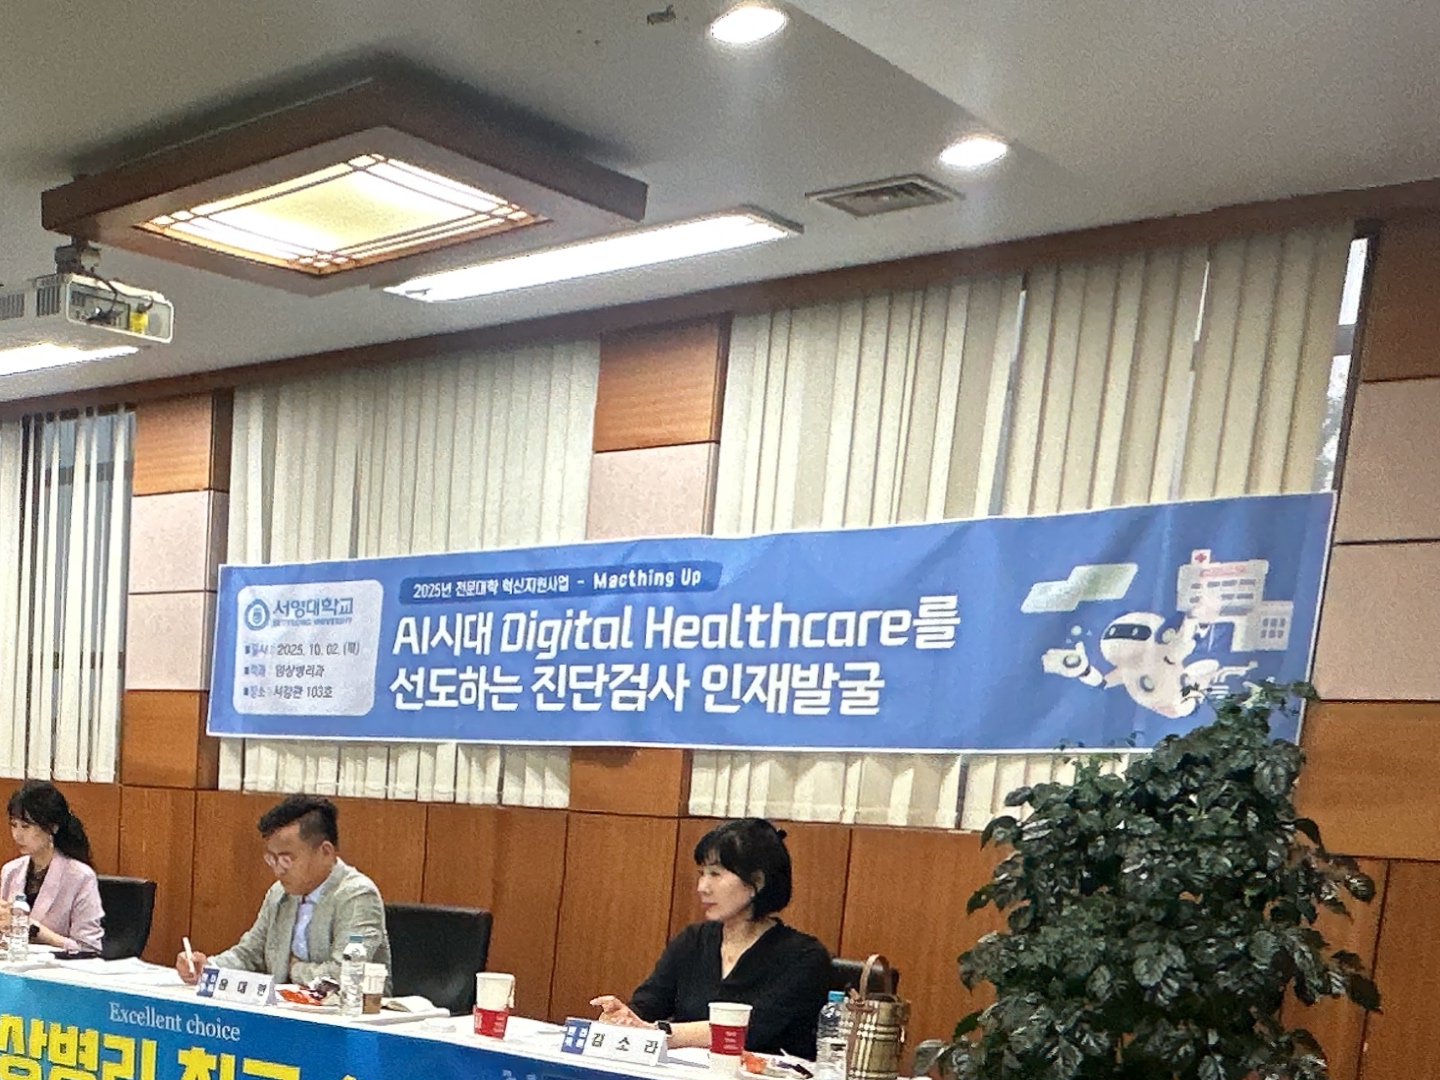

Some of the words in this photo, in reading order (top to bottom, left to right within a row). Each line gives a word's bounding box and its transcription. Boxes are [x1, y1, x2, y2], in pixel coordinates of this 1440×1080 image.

[413, 582, 451, 599] 2025년
[455, 578, 499, 597] 전문대학
[502, 575, 569, 595] 혁신지원사업
[594, 569, 674, 589] Macthing
[681, 568, 701, 586] Up
[272, 597, 354, 619] 서영대학교
[392, 611, 494, 656] AI시대
[499, 605, 633, 660] Digital
[645, 595, 960, 650] Healthcare를
[389, 664, 523, 712] 선도하는
[530, 662, 690, 712] 진단검사
[701, 661, 885, 716] 인재발굴
[109, 1002, 182, 1032] Excellent
[186, 1013, 241, 1042] choice
